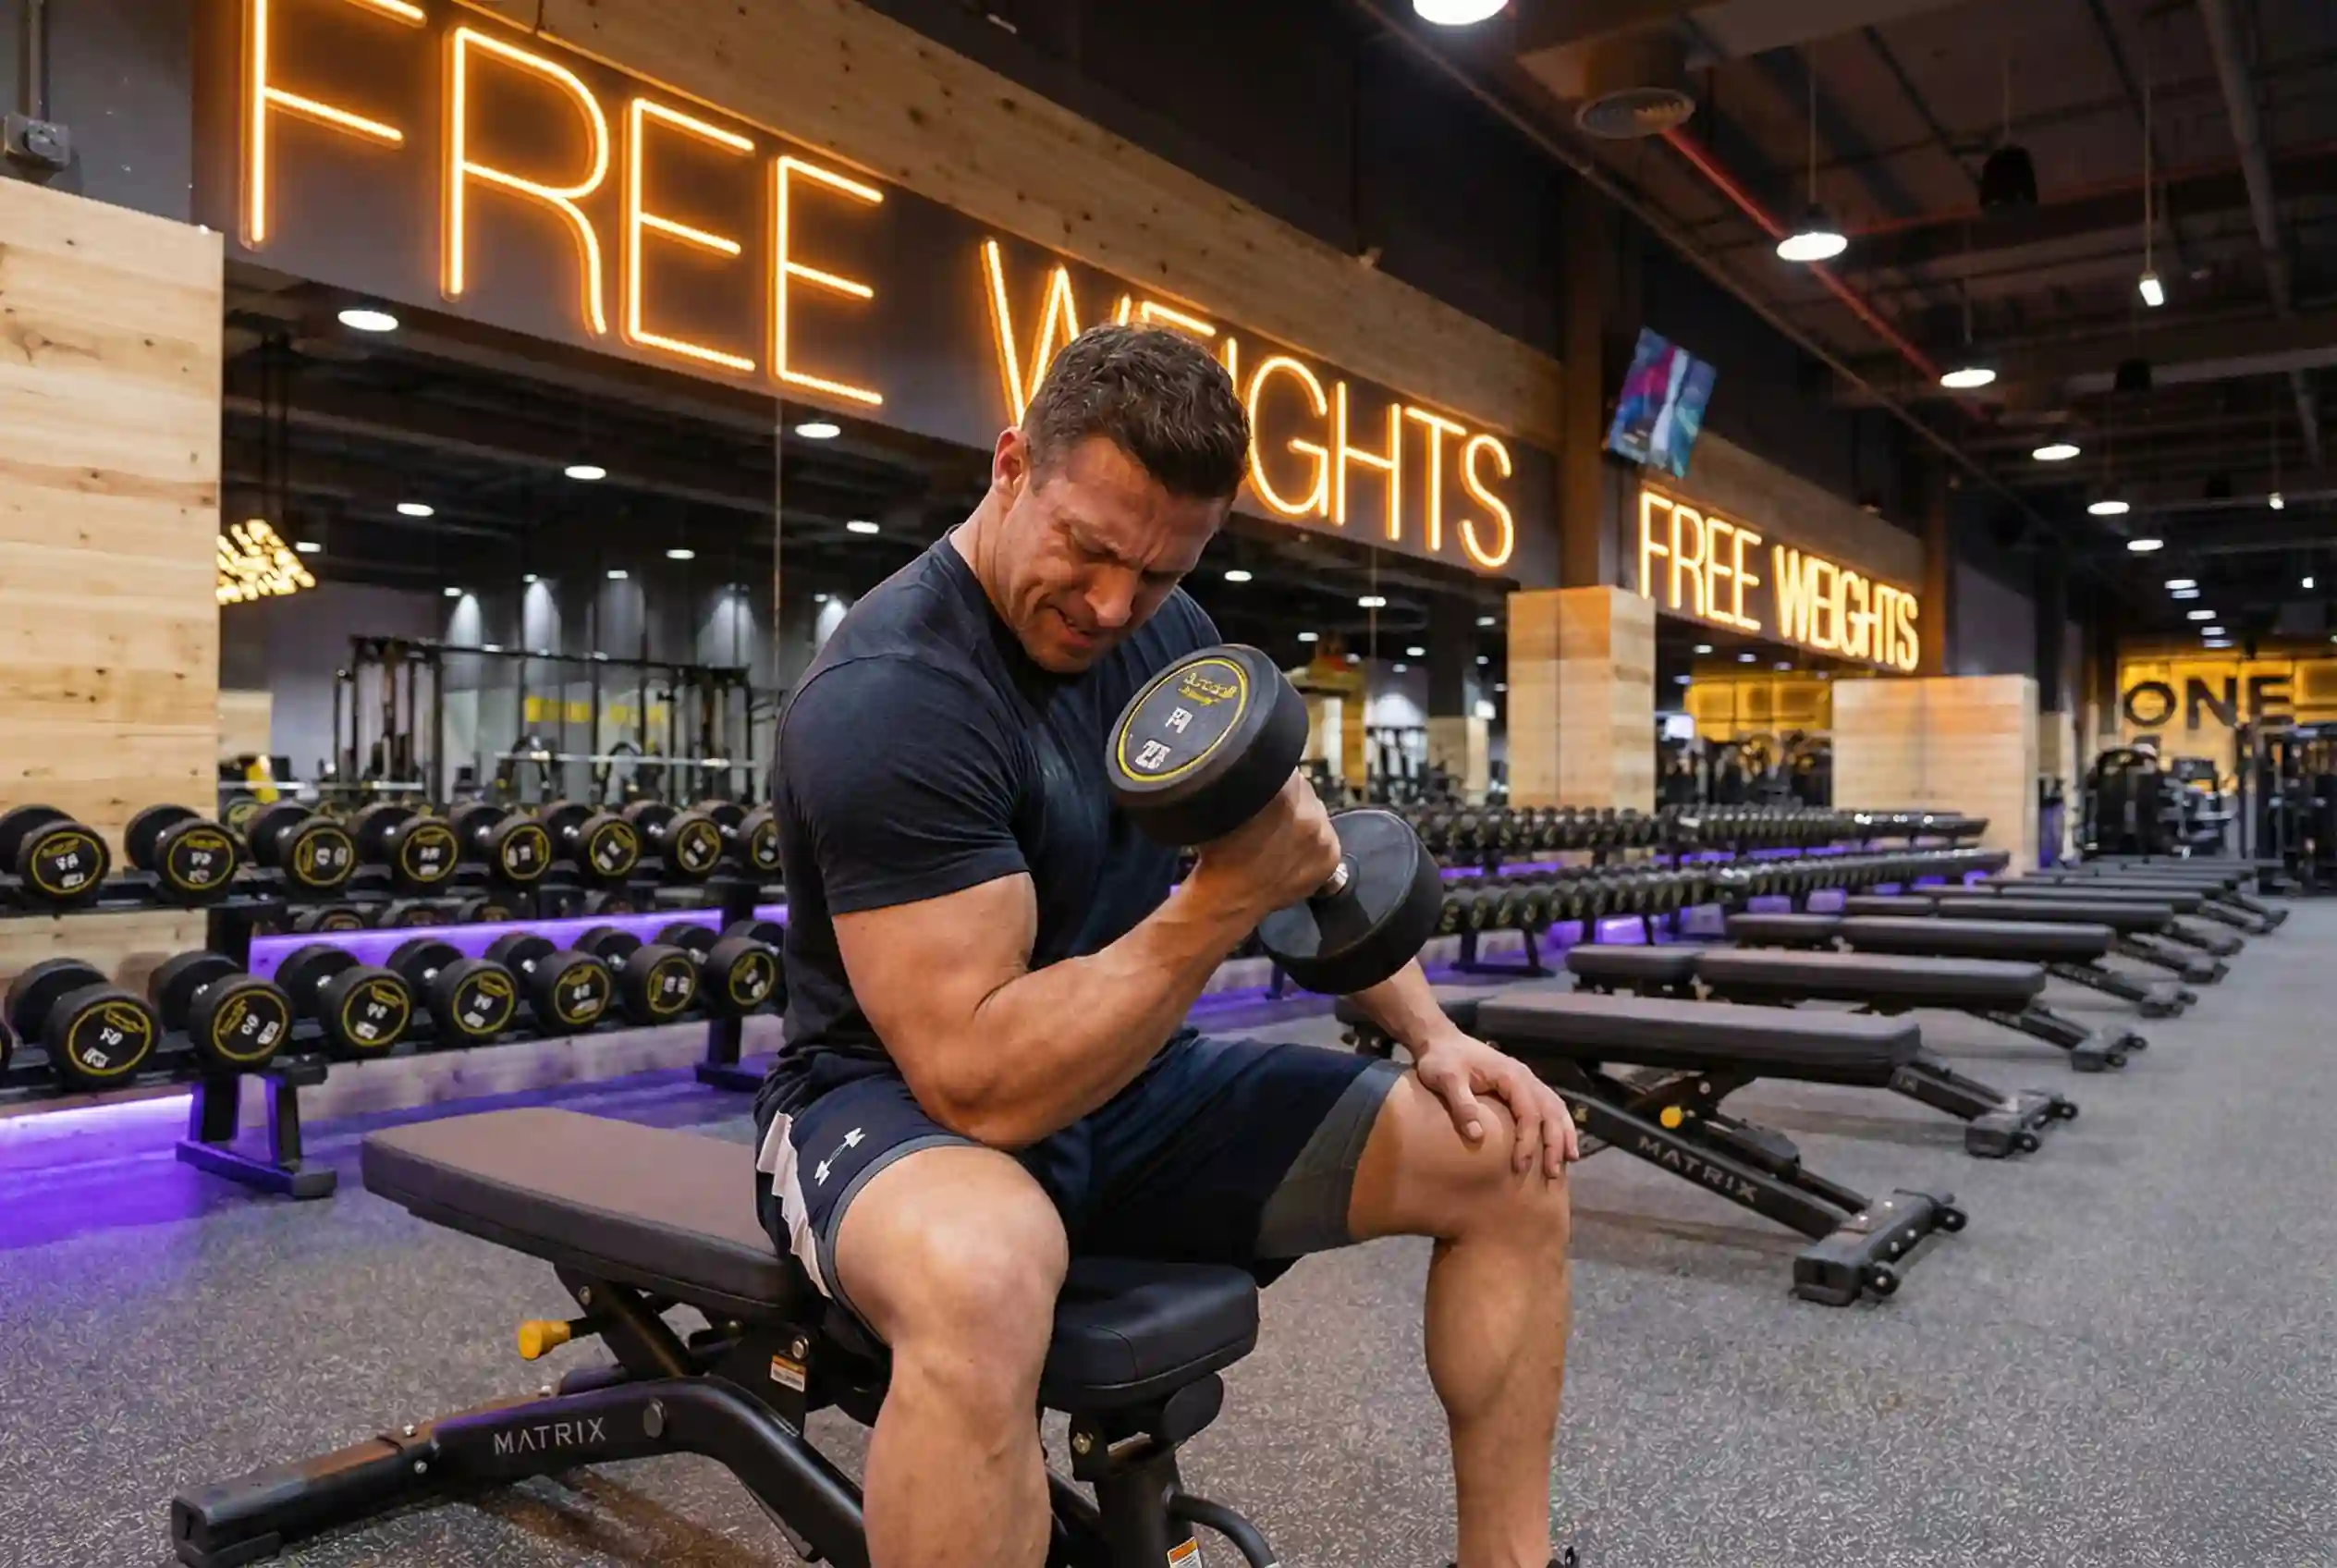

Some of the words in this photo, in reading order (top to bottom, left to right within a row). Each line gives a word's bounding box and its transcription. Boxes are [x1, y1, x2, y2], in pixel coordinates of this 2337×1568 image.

[242, 0, 884, 405] FREE
[982, 237, 1515, 570] WGHTS
[1638, 490, 1762, 631] FREE
[1773, 543, 1919, 673] WEIGHTS
[2123, 677, 2294, 730] ONE
[1638, 1134, 1758, 1203] MATRIX
[494, 1416, 606, 1456] MATRIX
